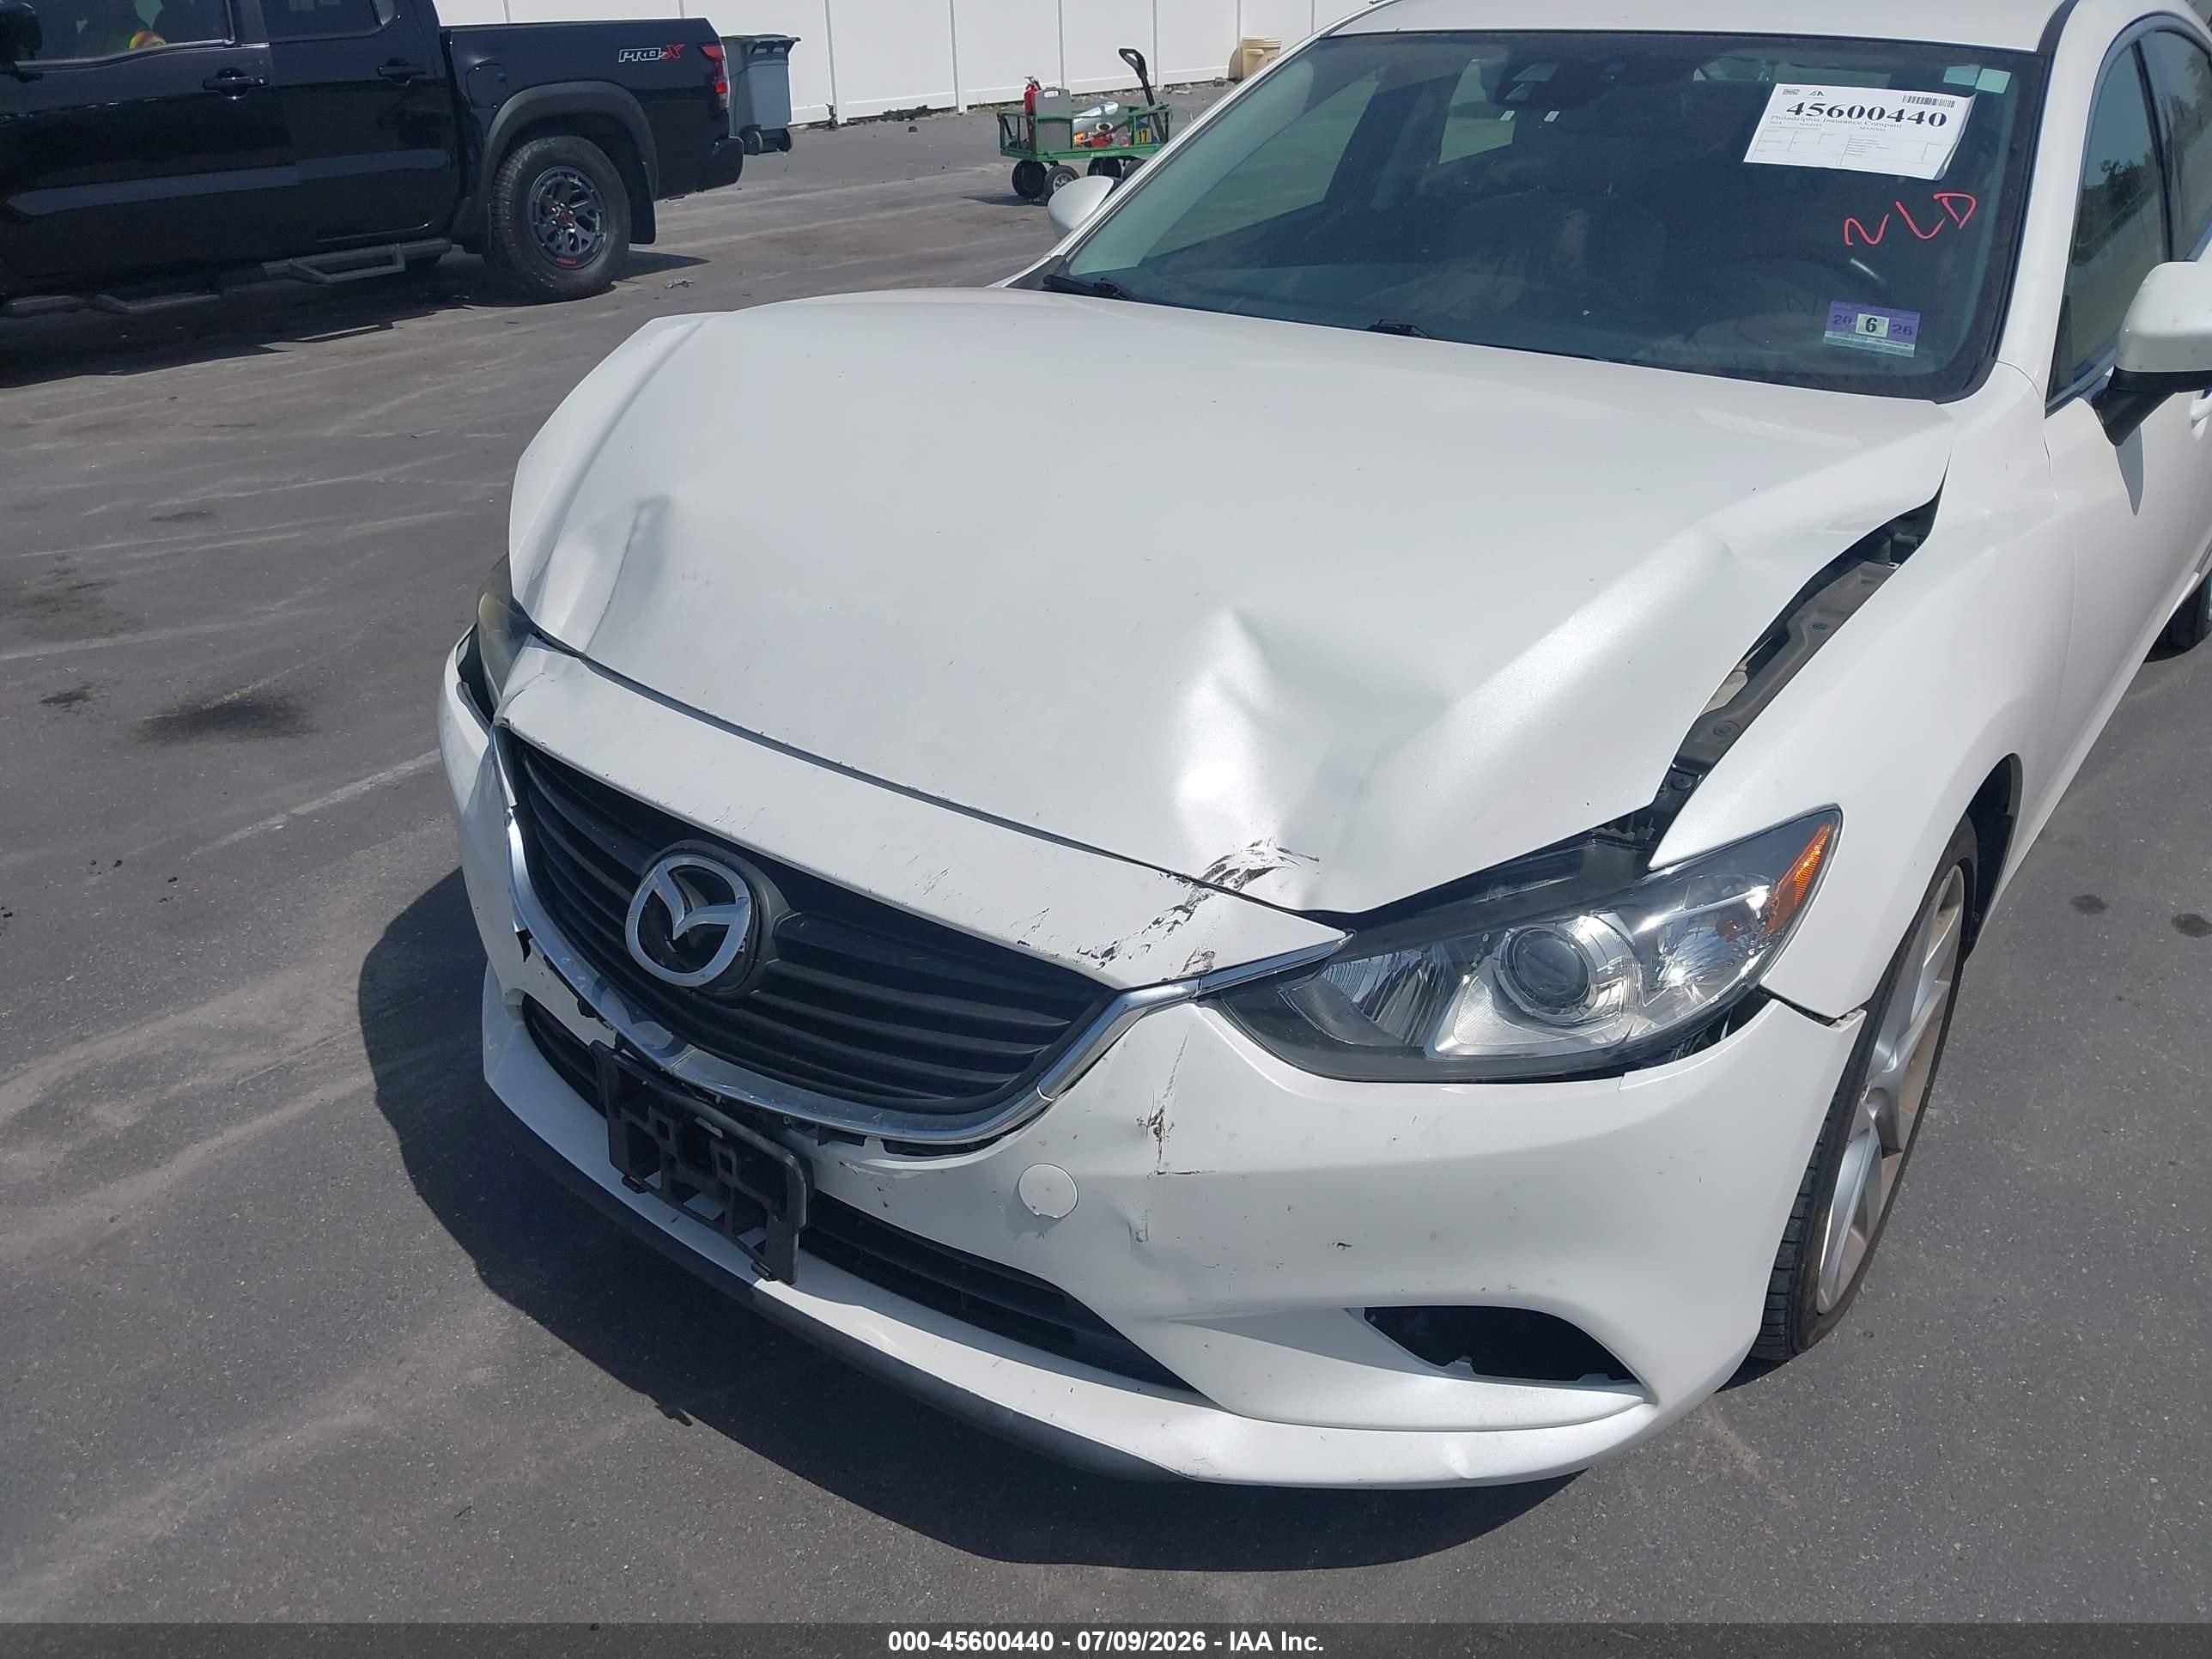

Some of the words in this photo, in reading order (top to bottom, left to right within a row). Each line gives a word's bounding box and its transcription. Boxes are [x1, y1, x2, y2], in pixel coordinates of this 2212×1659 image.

[1771, 114, 1820, 124] Philadelphia
[1785, 101, 1948, 128] 45600440
[1832, 314, 1852, 325] 20
[1865, 317, 1878, 333] 6
[1893, 324, 1914, 337] 26
